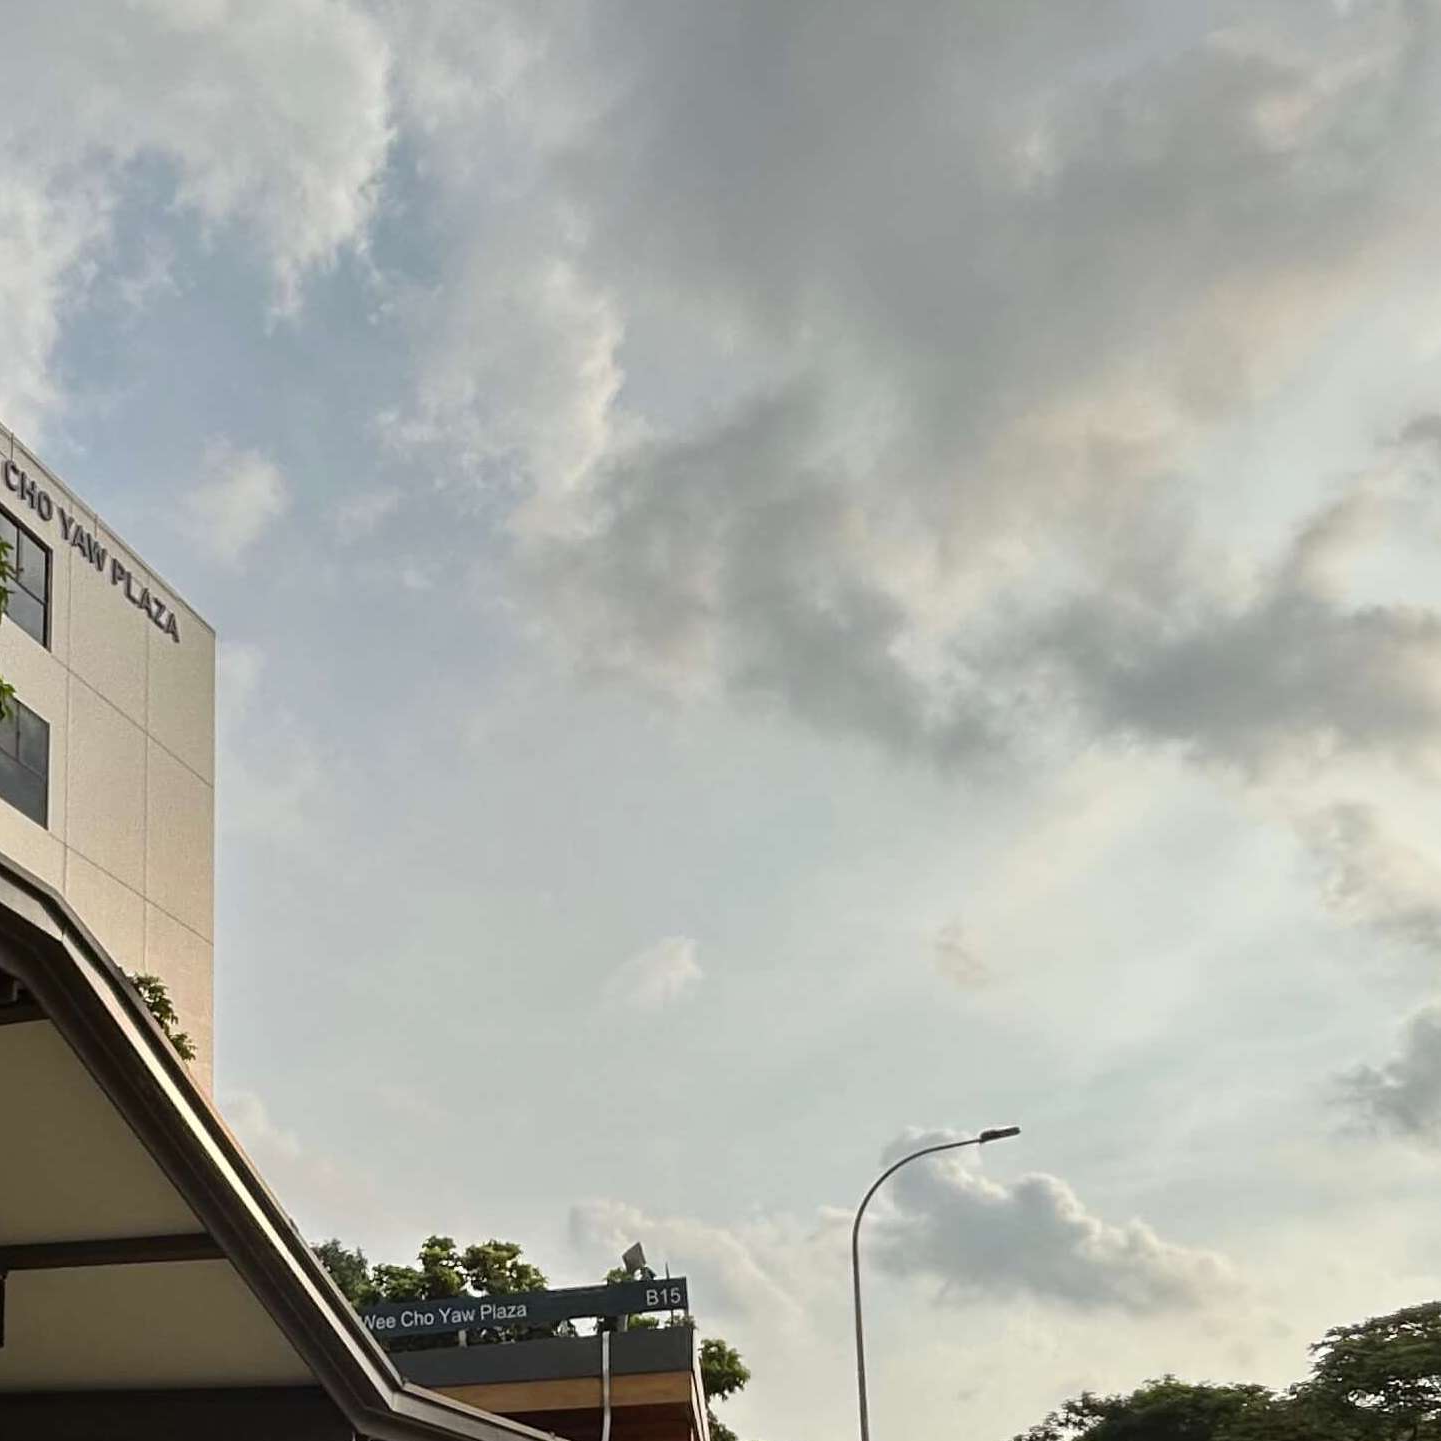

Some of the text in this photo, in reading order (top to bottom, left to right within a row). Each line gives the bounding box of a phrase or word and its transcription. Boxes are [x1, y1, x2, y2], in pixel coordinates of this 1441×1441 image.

[2, 459, 53, 522] CHO
[57, 506, 107, 572] YAW
[110, 557, 180, 643] PLAZA
[646, 1287, 681, 1306] B15
[360, 1303, 527, 1330] Wee Cho Yaw Plaza
